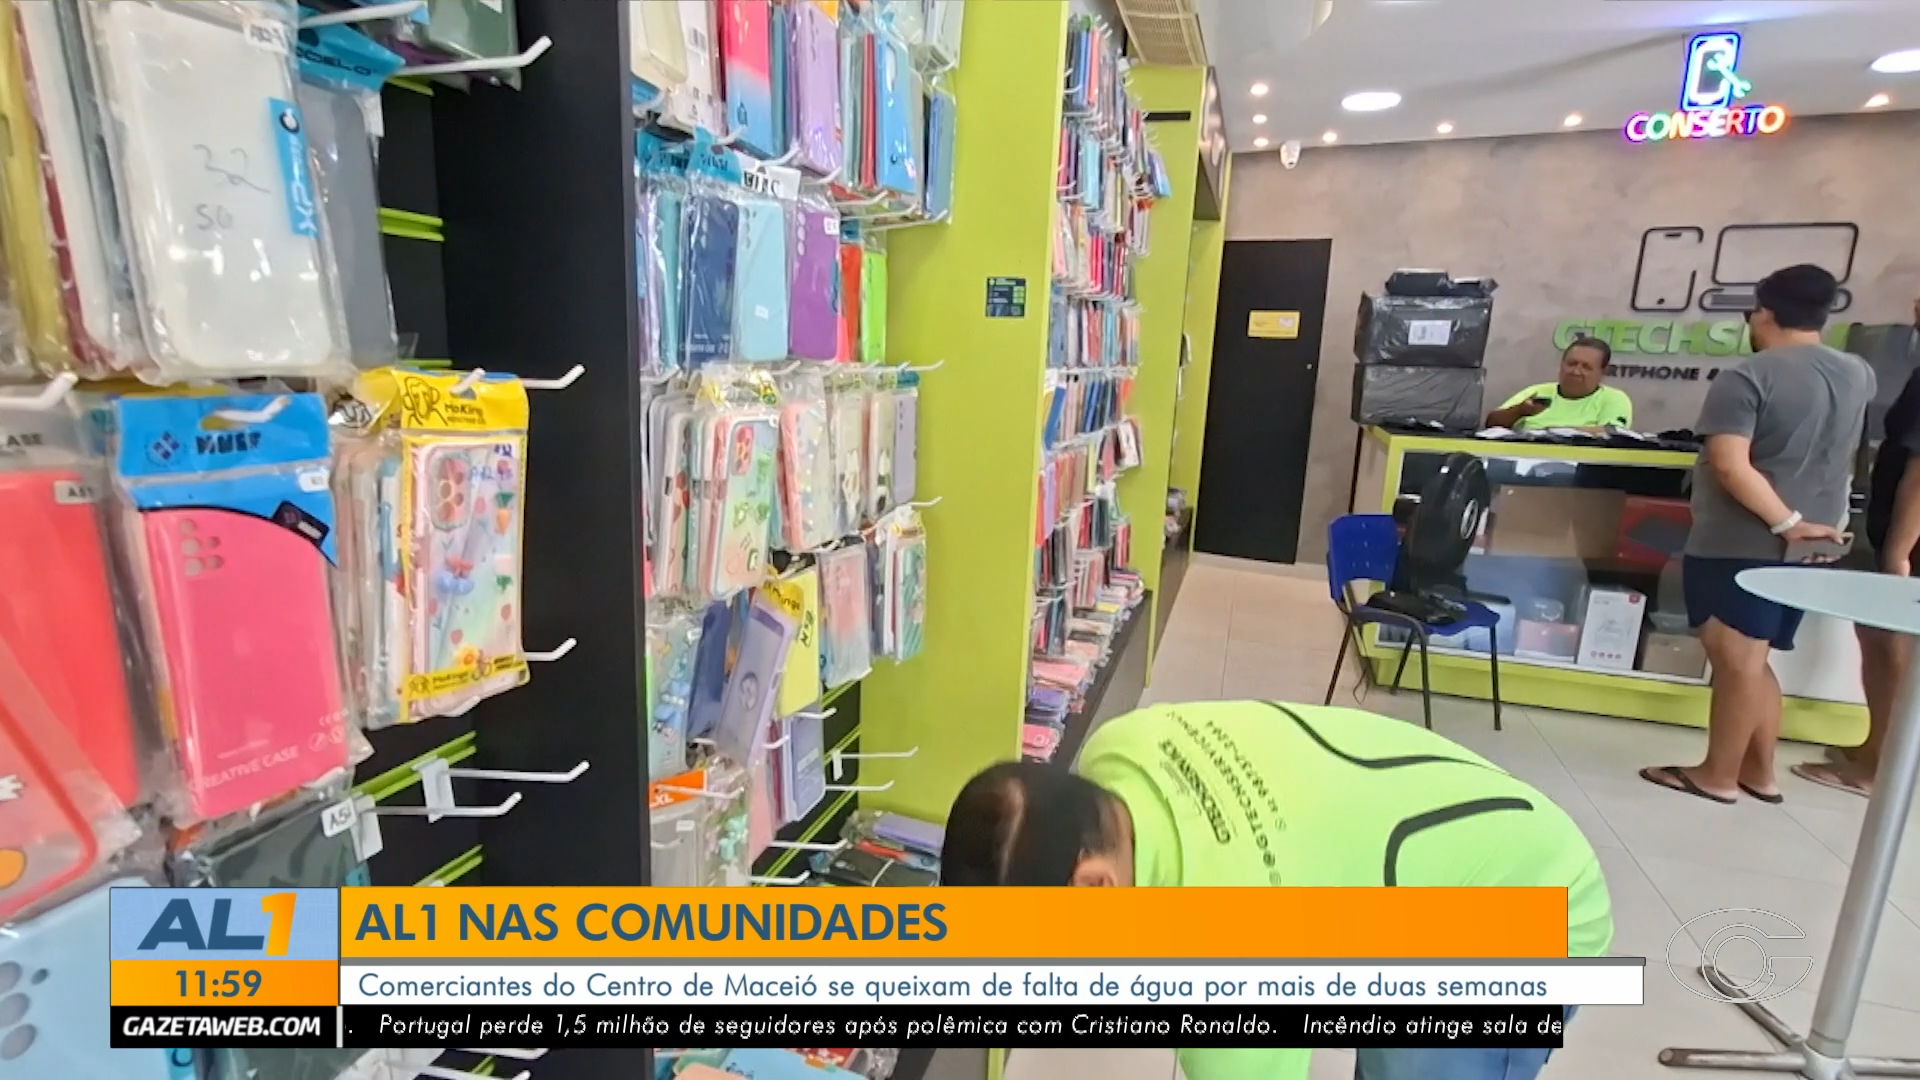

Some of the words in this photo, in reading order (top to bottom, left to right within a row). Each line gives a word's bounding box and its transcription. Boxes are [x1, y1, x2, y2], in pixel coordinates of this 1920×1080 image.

[1625, 104, 1787, 142] CONSERTO
[1605, 364, 1700, 381] RTPHONE
[261, 744, 300, 768] CASE
